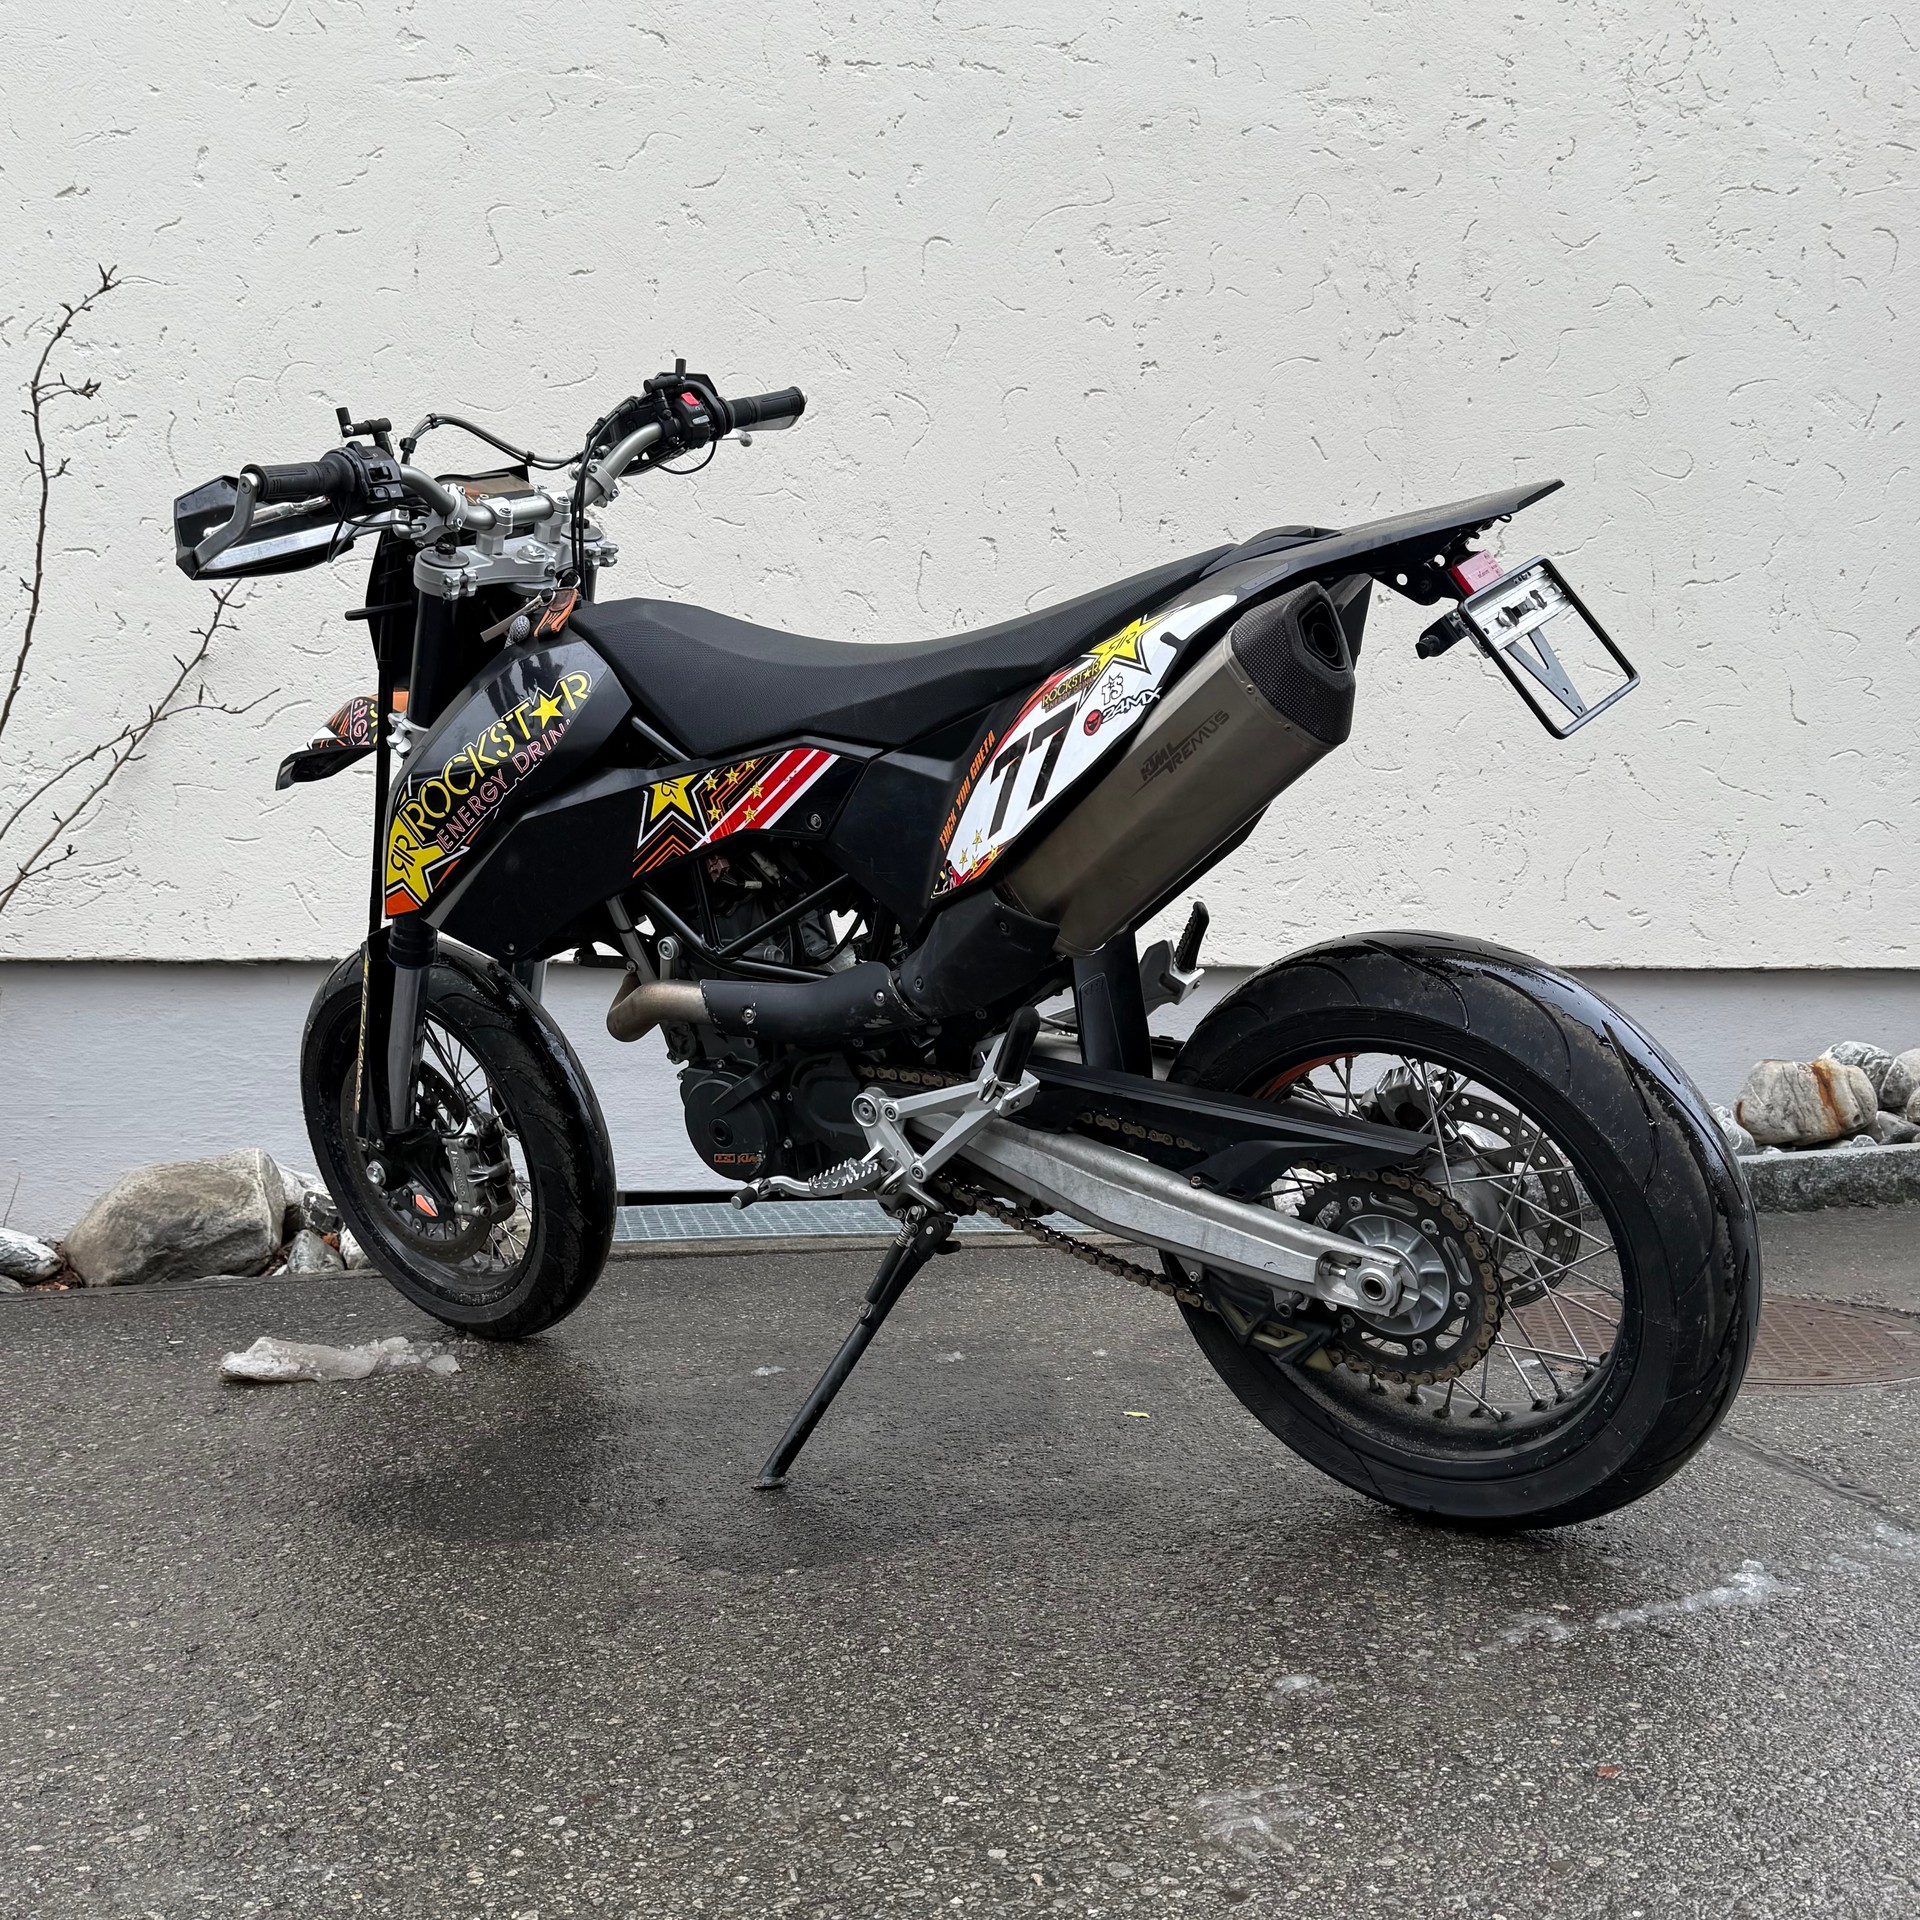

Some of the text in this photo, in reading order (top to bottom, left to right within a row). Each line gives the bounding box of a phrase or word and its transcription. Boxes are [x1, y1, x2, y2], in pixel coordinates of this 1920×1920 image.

[1101, 687, 1162, 724] 24MX
[1171, 710, 1230, 770] REMUS
[436, 718, 571, 849] ENERGY DRIN
[939, 808, 957, 851] FUCK
[956, 776, 971, 810] YOU
[969, 730, 996, 781] GRETA
[987, 702, 1078, 840] 77
